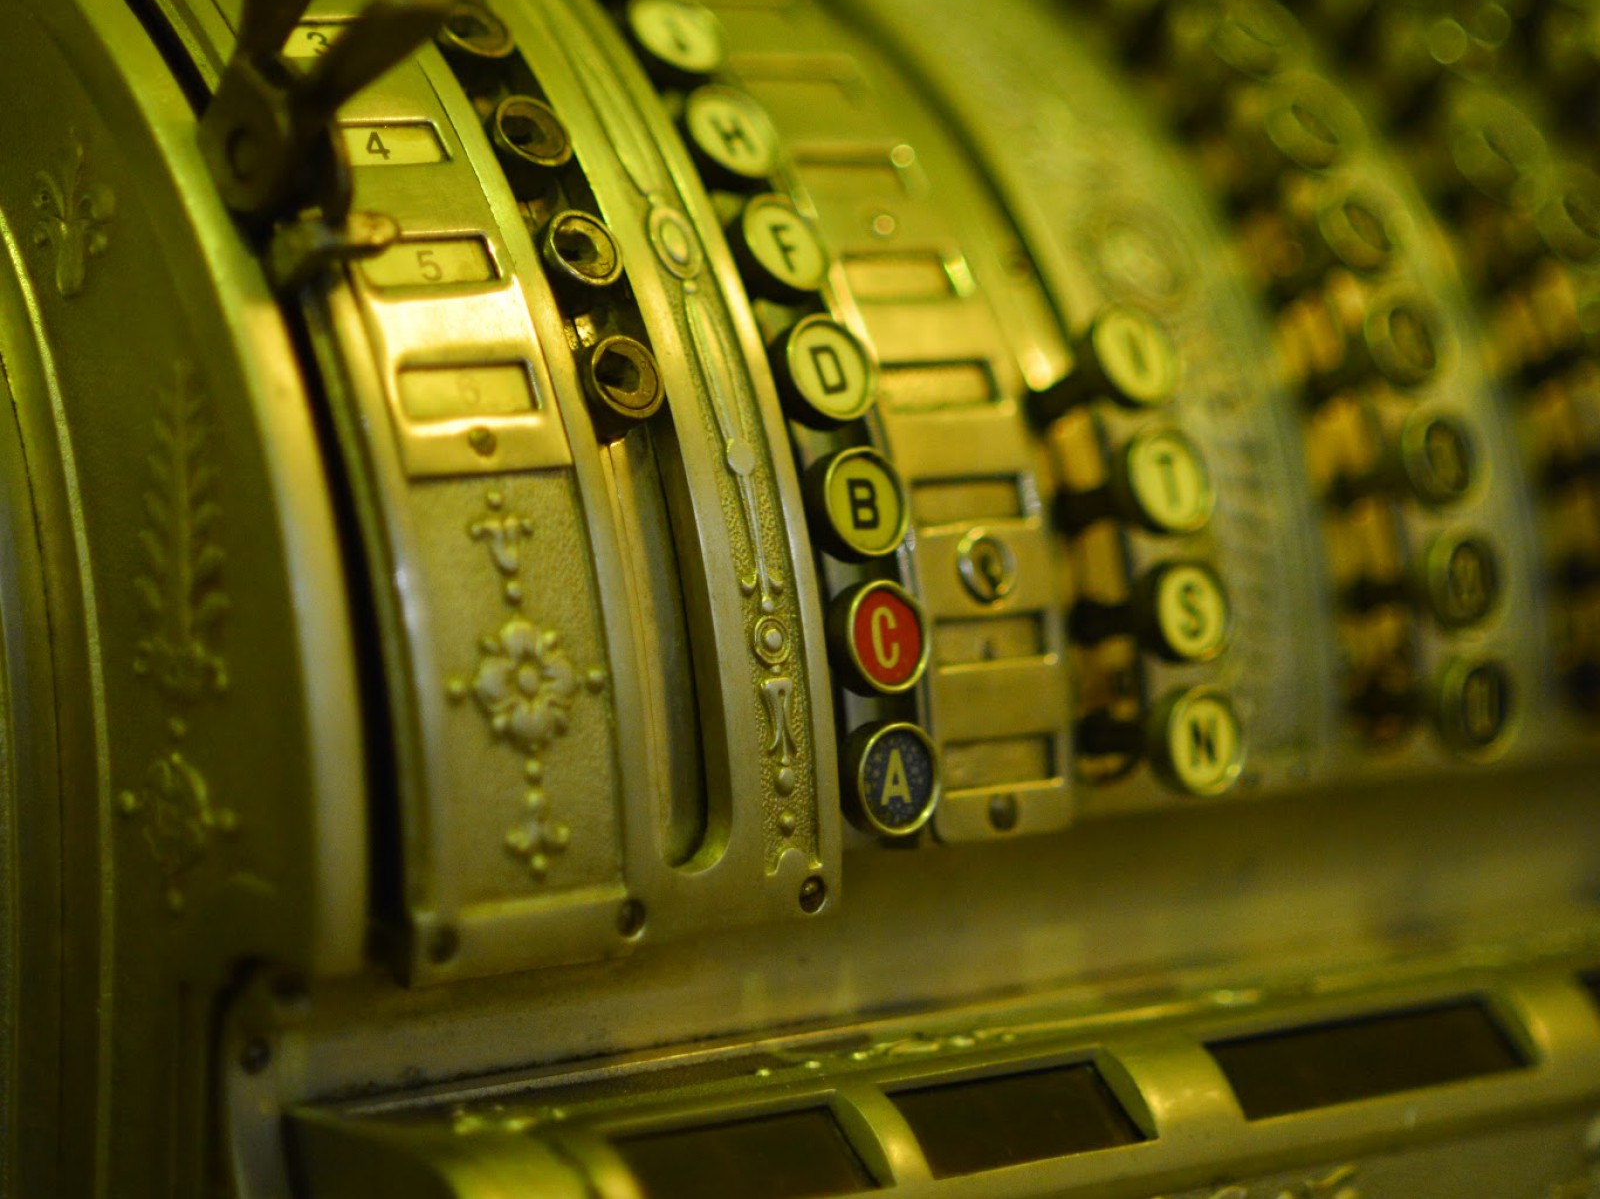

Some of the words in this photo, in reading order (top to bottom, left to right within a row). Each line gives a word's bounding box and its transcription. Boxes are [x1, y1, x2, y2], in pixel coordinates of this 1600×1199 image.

[366, 131, 391, 160] 4
[709, 115, 749, 156] H
[416, 249, 442, 282] 5
[770, 223, 798, 274] F
[809, 344, 848, 396] D
[846, 478, 880, 530] B
[1179, 580, 1208, 638] S
[870, 606, 901, 669] C
[1186, 724, 1218, 771] N
[879, 748, 912, 806] A
